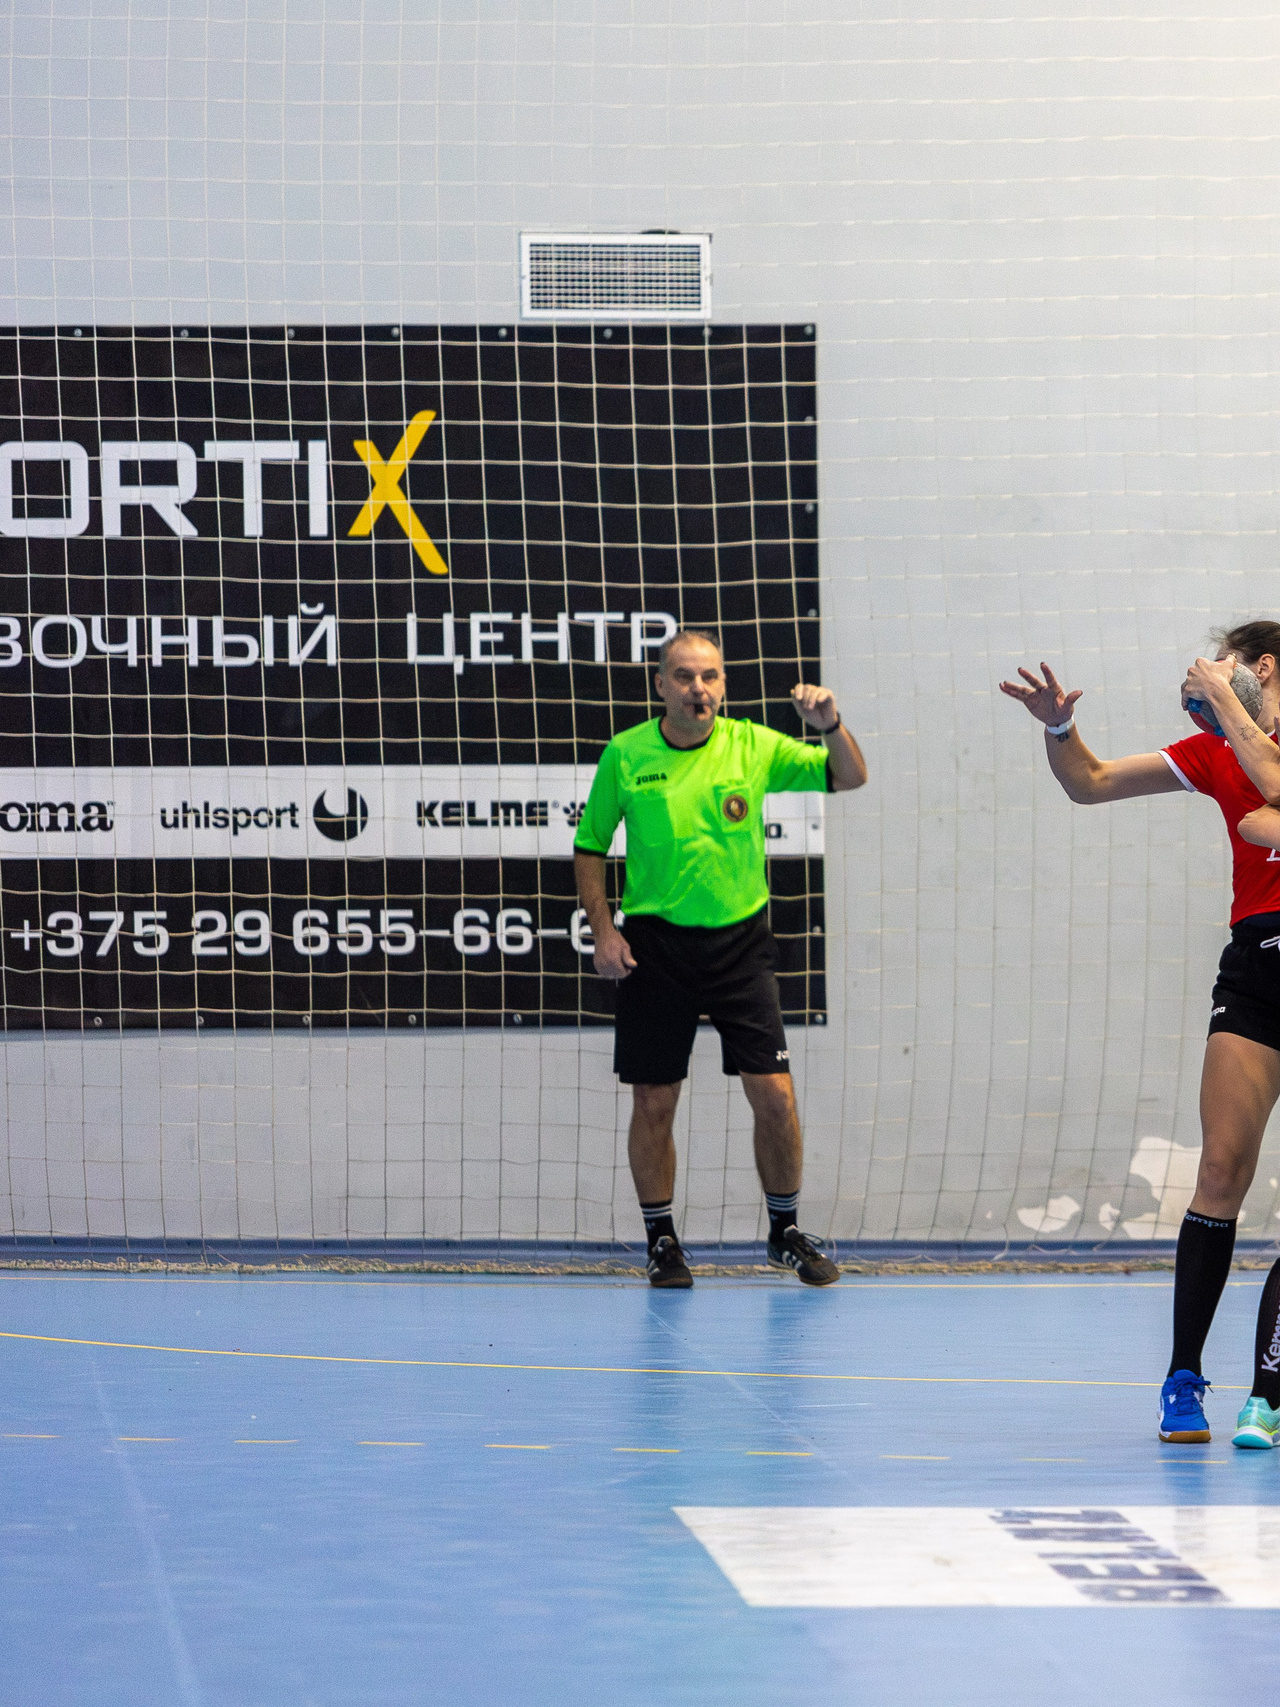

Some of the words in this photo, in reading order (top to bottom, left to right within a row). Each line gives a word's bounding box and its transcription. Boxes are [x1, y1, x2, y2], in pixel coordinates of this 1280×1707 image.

[0, 410, 448, 574] ORTIX
[406, 611, 679, 675] ЦЕНТР
[160, 801, 300, 836] uhlsport
[416, 800, 549, 827] KELME
[11, 911, 170, 957] +375
[192, 910, 271, 957] 29
